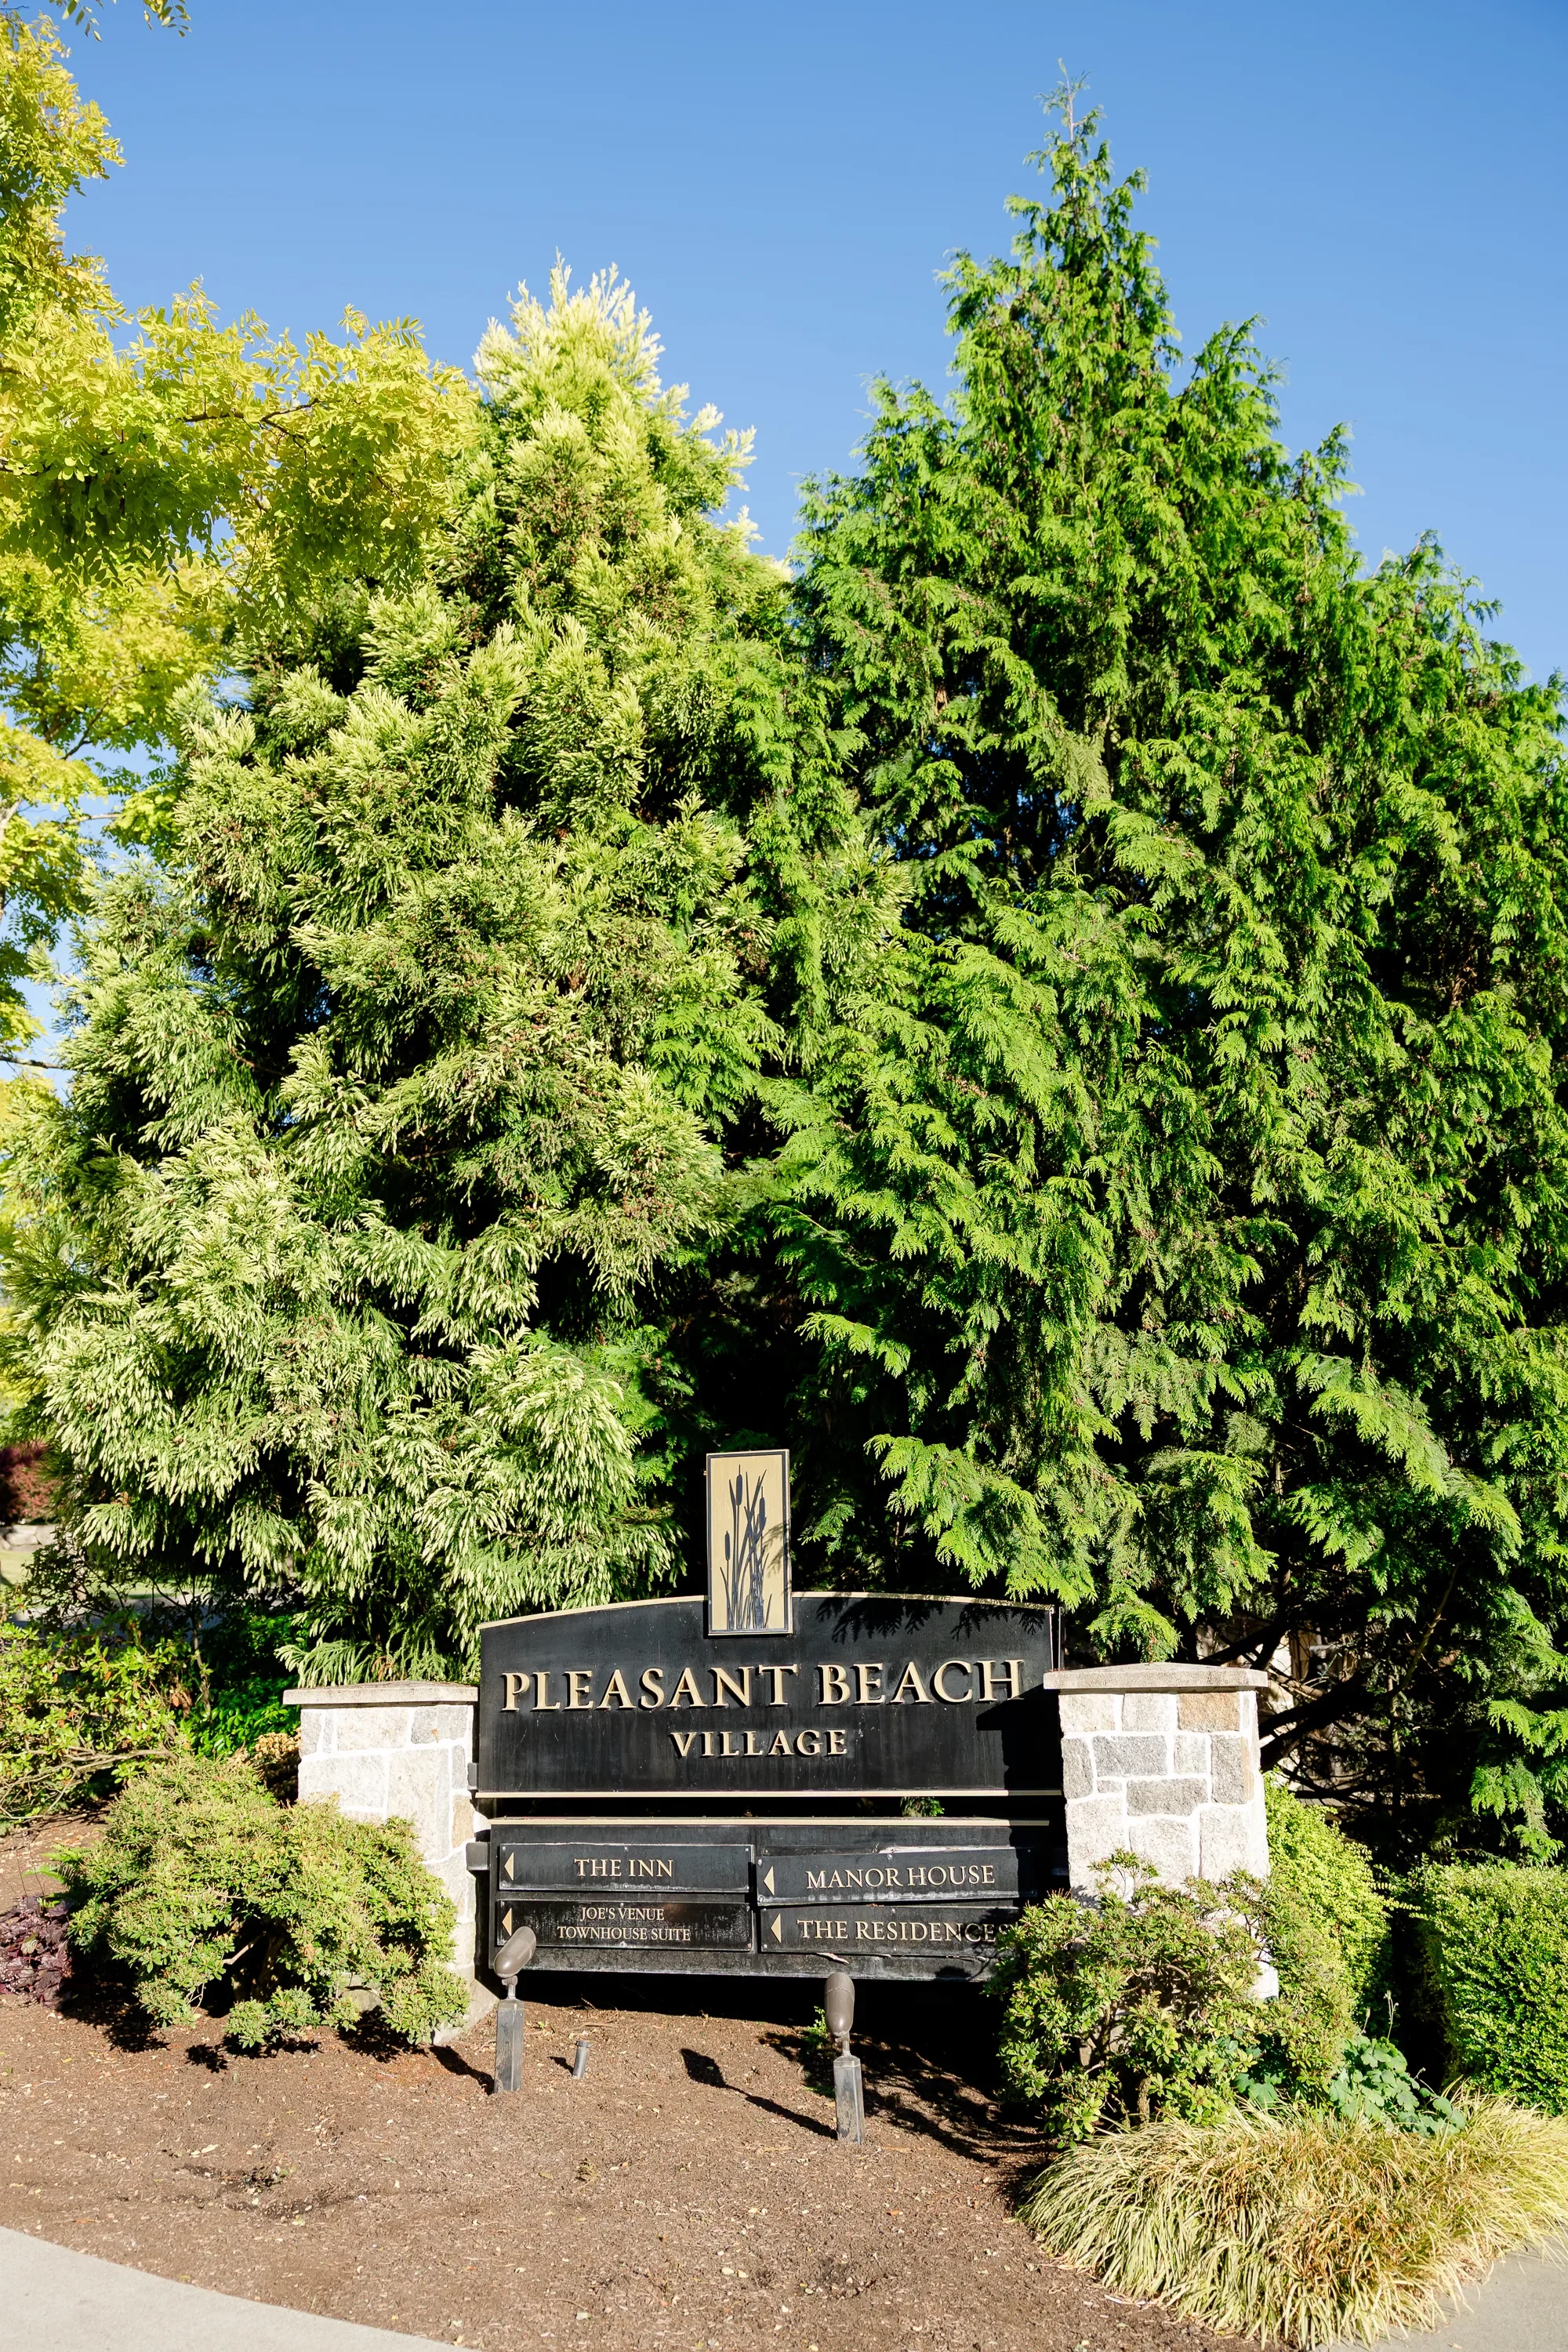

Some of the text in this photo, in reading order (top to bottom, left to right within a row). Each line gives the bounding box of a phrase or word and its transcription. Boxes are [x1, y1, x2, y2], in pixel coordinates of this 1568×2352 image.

[501, 1659, 1025, 1712] PLEASANT BEACH
[670, 1729, 848, 1758] VILLAGE
[574, 1857, 674, 1878] THE INN
[805, 1864, 996, 1889] MANOR HOUSE
[580, 1907, 665, 1922] JOE'S VENUE
[557, 1926, 691, 1941] TOWNHOUSE SUITE
[797, 1919, 848, 1940] THE
